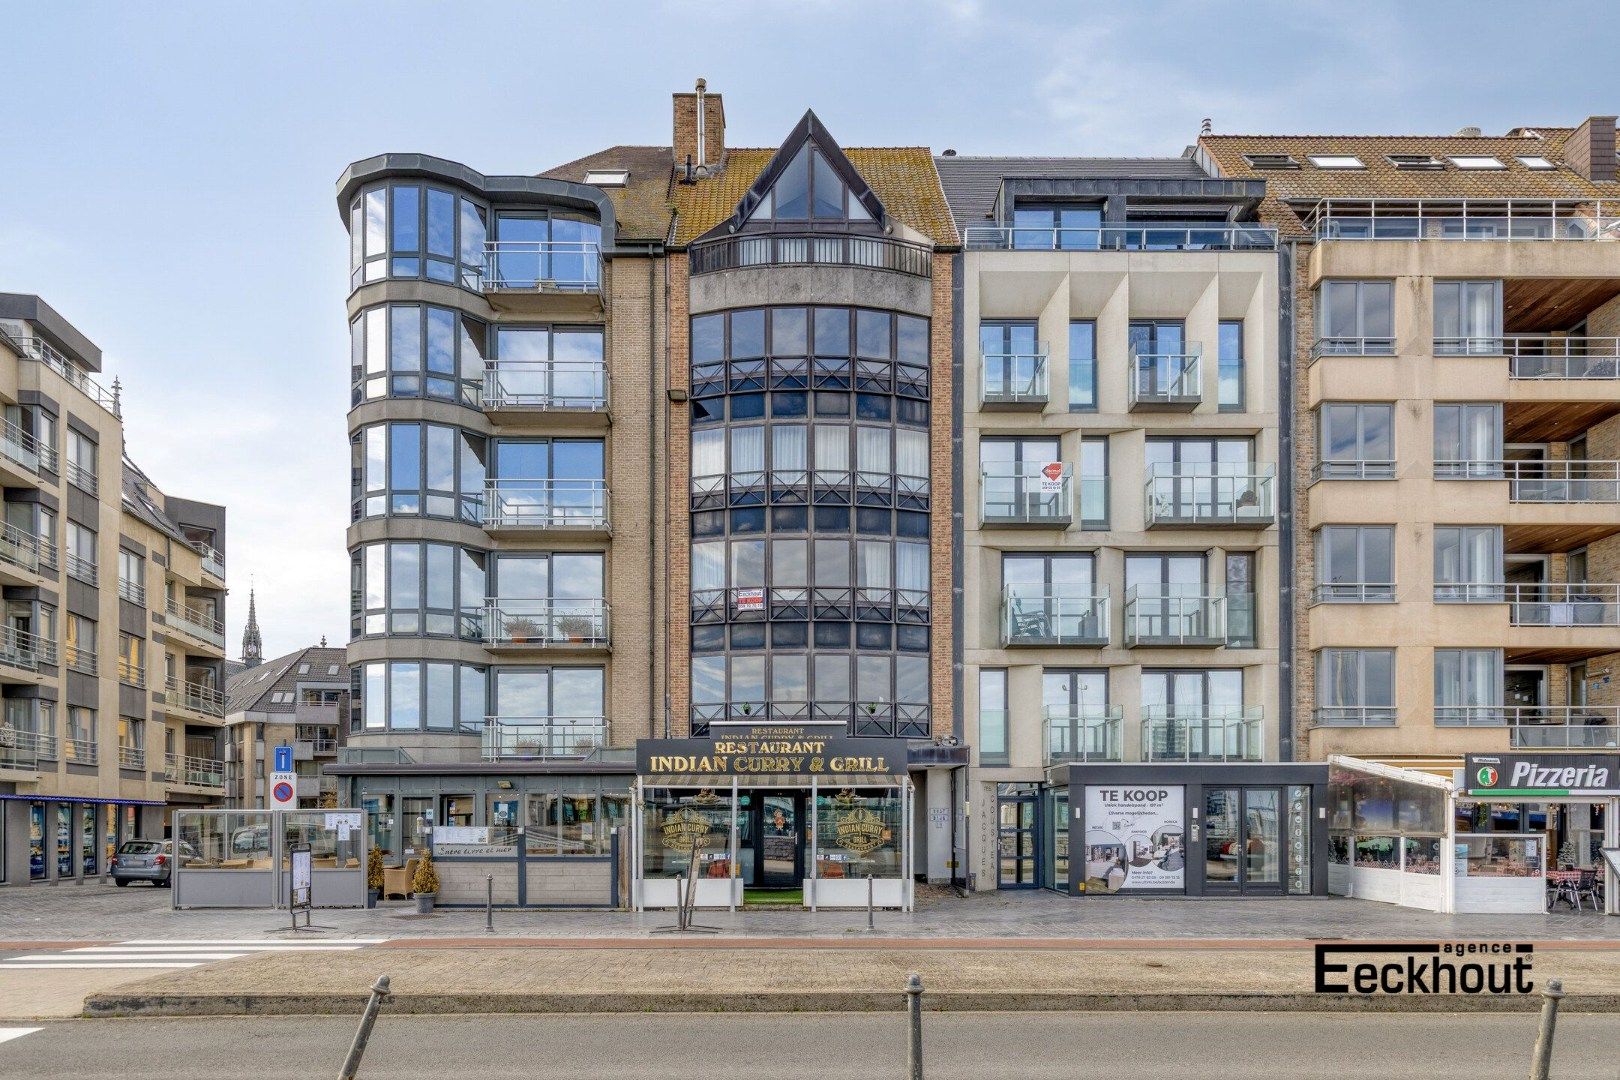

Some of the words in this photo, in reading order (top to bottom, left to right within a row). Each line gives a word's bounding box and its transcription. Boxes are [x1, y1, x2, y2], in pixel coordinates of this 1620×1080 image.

[714, 741, 825, 754] RESTAURANT
[650, 756, 728, 772] INDIAN
[733, 757, 804, 772] CURRY
[809, 757, 825, 772] &
[829, 757, 889, 773] GRILL
[1510, 761, 1609, 787] Pizzeria
[1100, 790, 1118, 801] TE
[1123, 790, 1168, 802] KOOP
[687, 823, 709, 834] CURRY
[837, 823, 860, 836] INDIAN
[861, 823, 883, 835] CURRY
